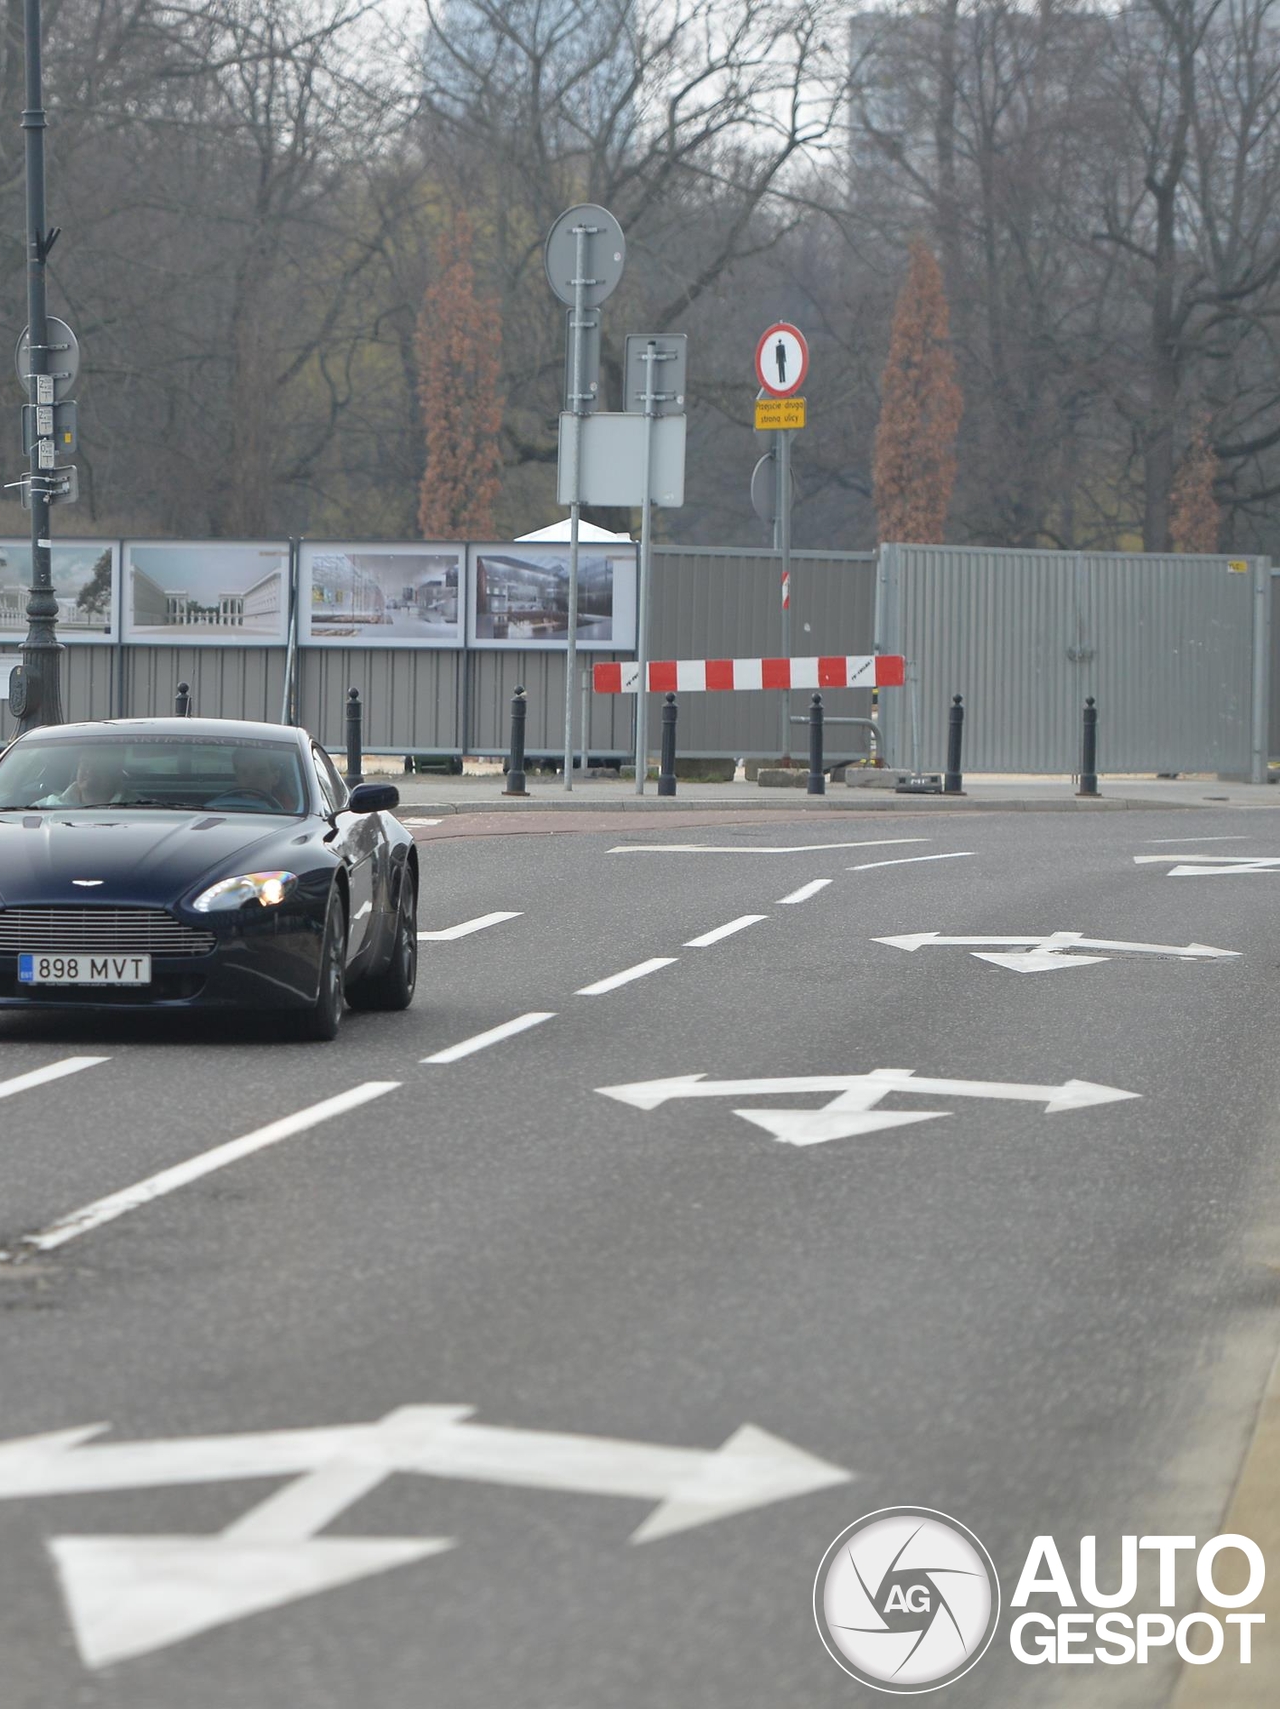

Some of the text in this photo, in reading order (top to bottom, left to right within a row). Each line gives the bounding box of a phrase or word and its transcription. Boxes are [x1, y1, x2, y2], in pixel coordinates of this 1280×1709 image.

[21, 971, 33, 979] EST
[39, 959, 143, 979] 898 MVT
